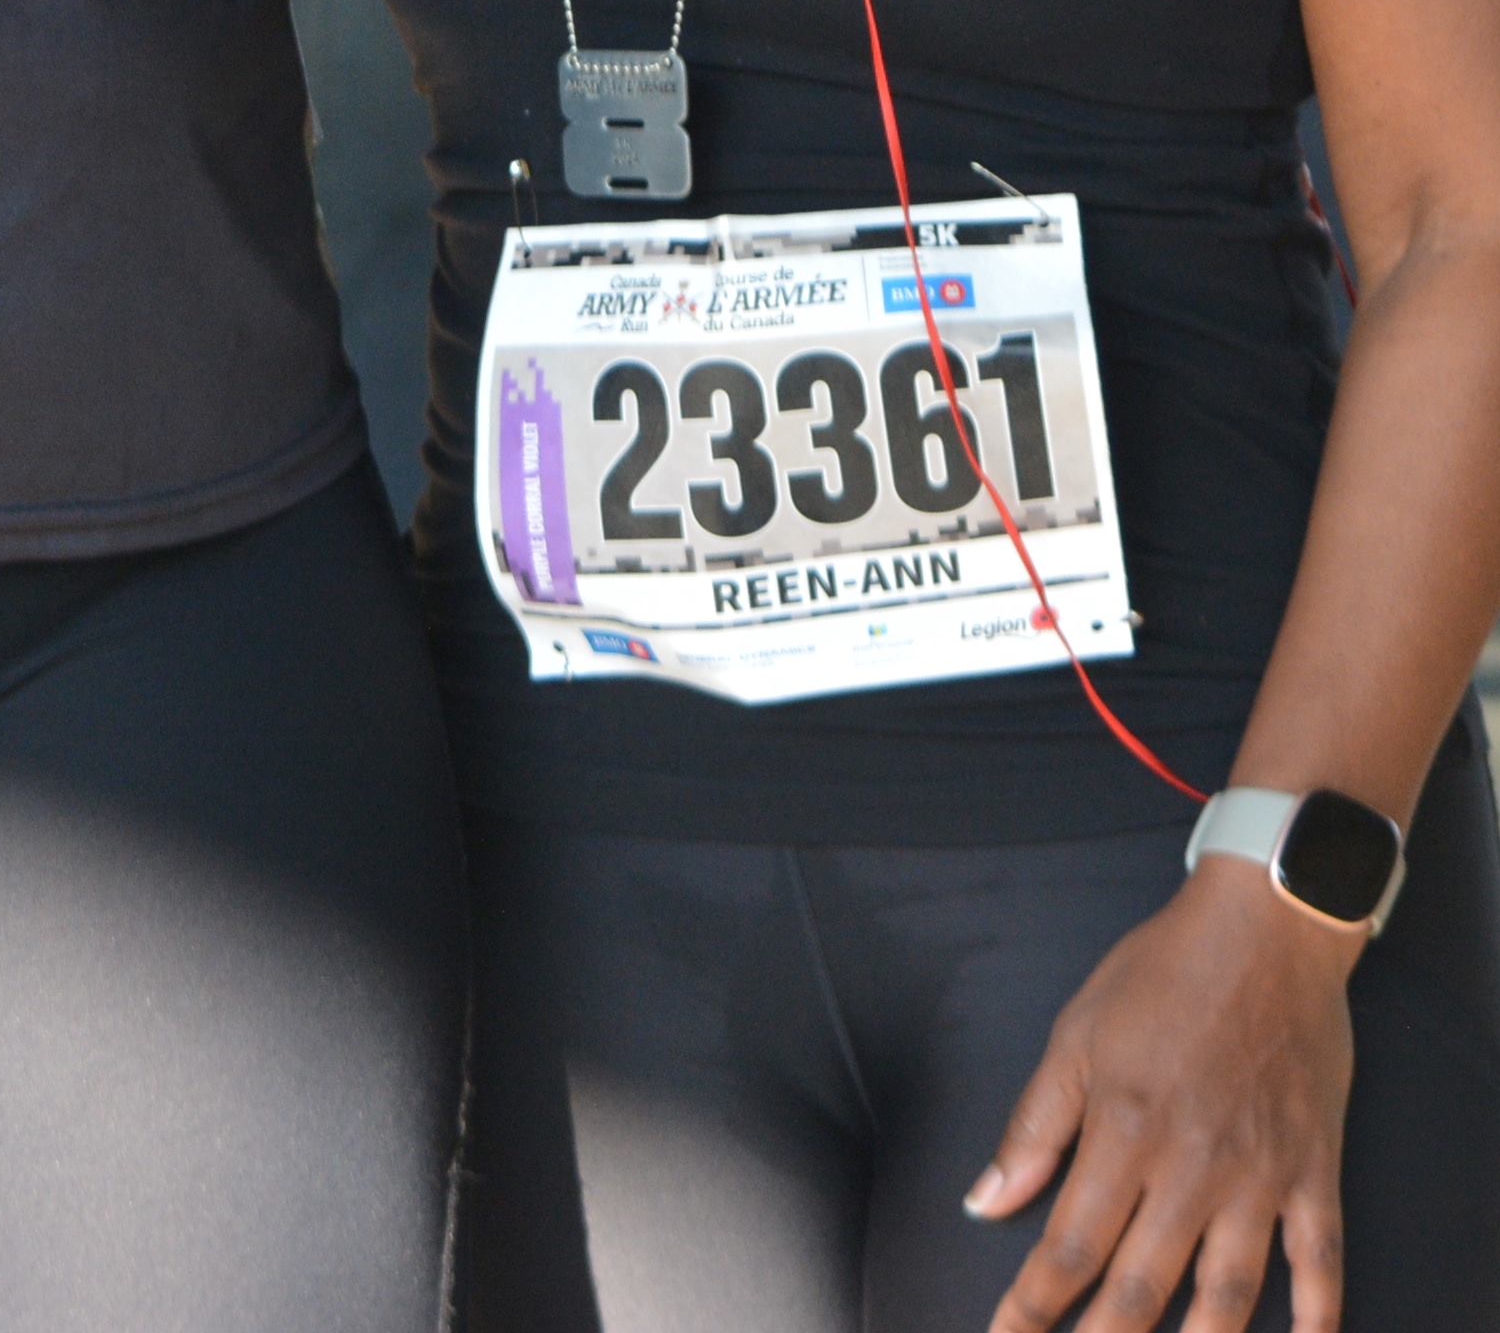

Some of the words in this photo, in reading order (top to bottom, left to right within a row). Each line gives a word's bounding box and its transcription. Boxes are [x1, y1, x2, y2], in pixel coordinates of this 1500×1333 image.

[918, 222, 960, 247] 5K
[610, 273, 662, 290] Canada
[773, 265, 795, 282] de
[577, 292, 656, 317] ARMY
[706, 272, 848, 314] L'ARMÉE
[620, 316, 649, 333] Run
[703, 314, 724, 332] du
[729, 312, 795, 331] Canada
[522, 420, 539, 472] VIOLET
[591, 330, 1055, 541] 23361
[712, 548, 962, 613] REEN-ANN
[960, 615, 1027, 641] Legion
